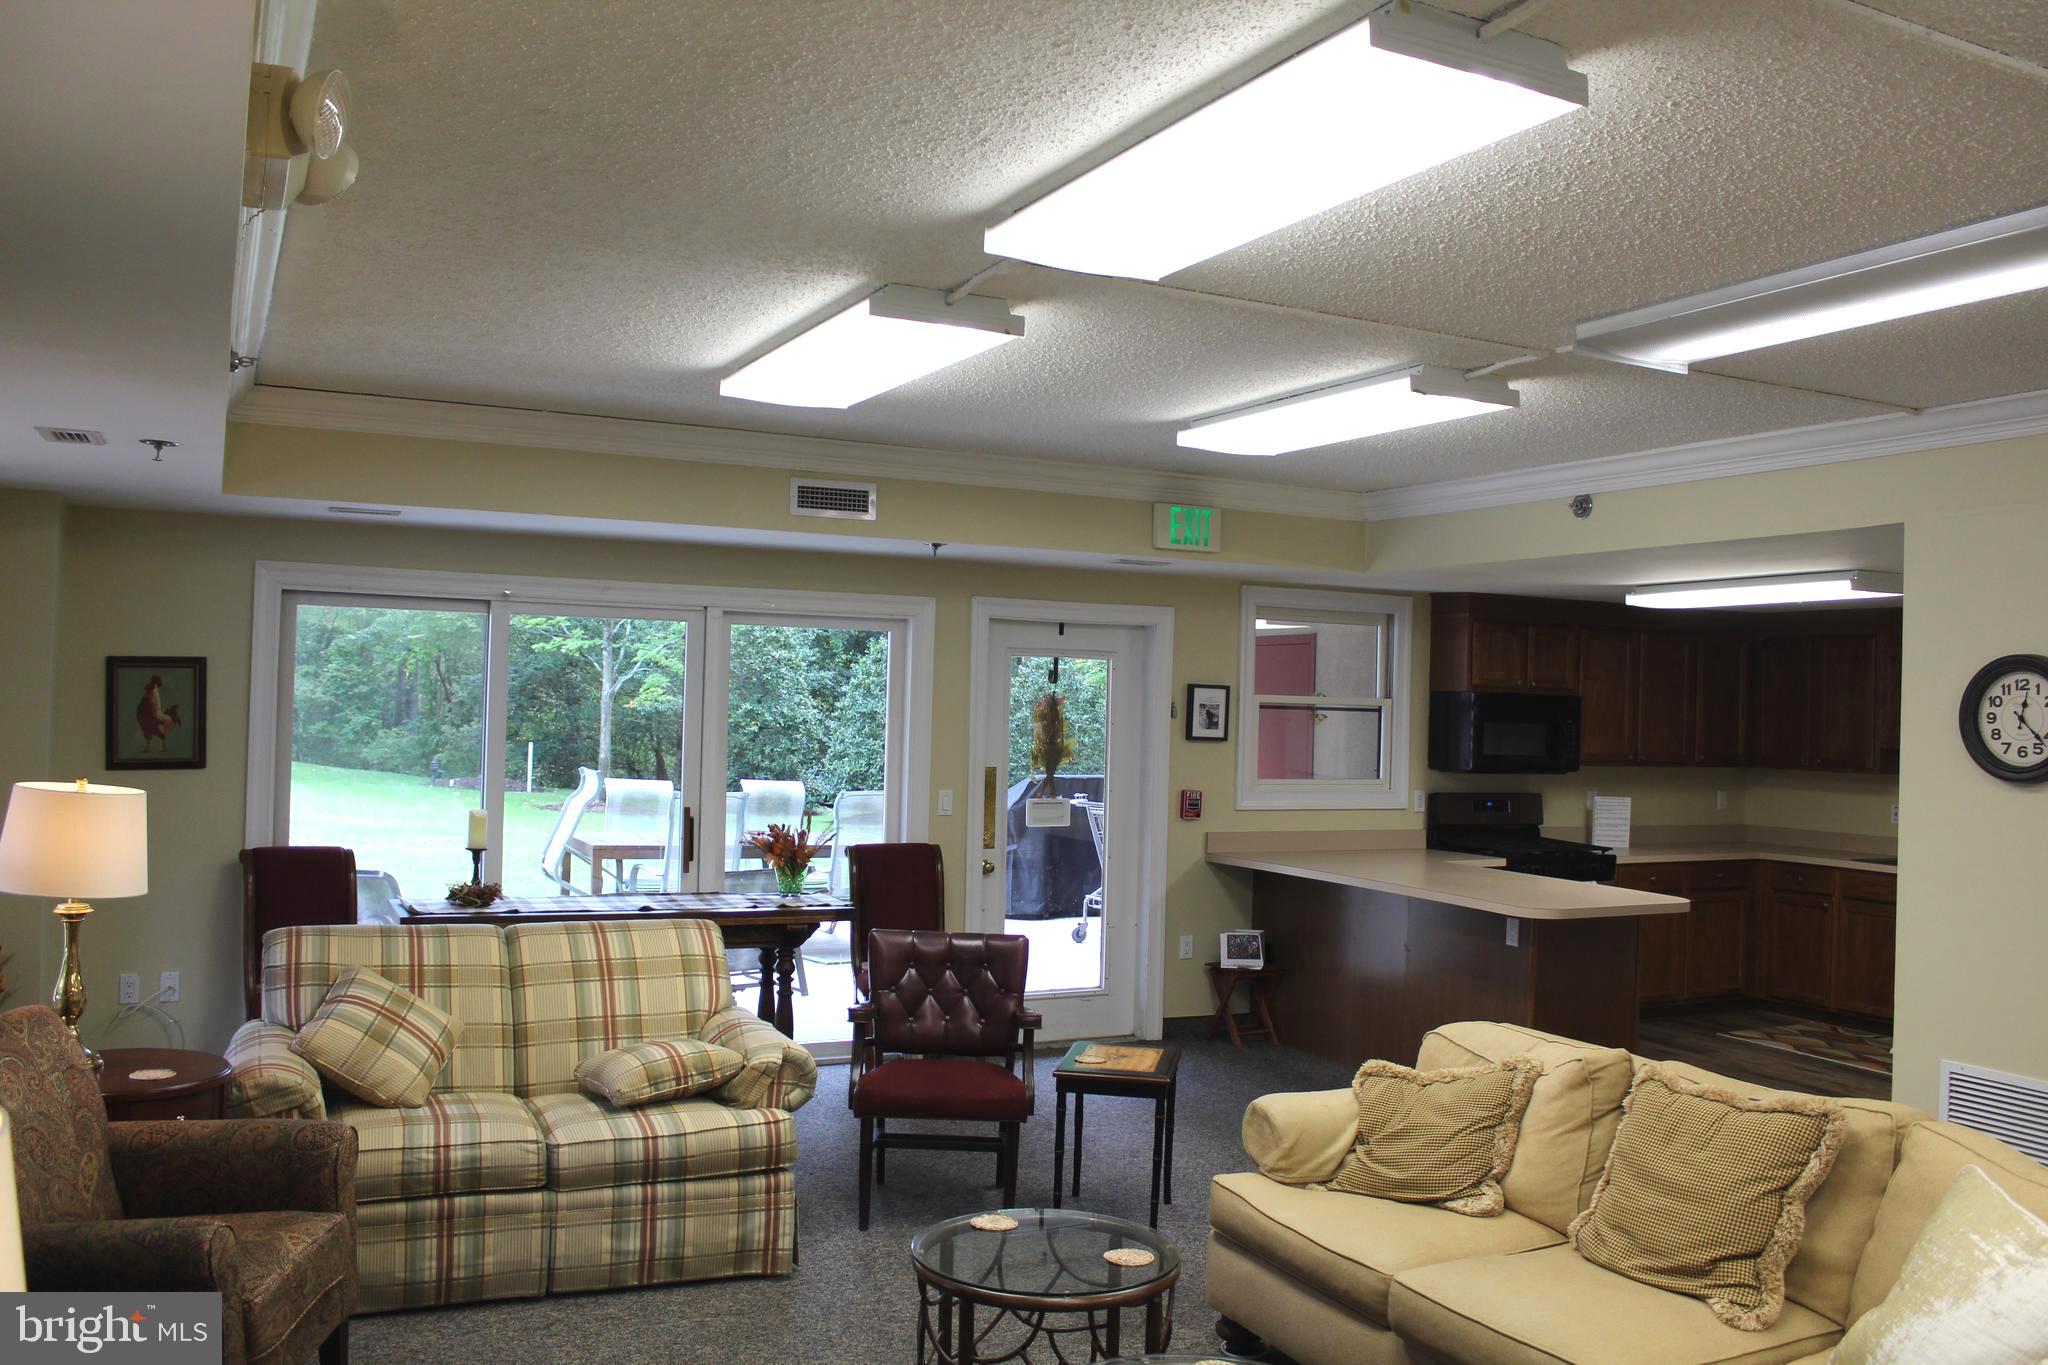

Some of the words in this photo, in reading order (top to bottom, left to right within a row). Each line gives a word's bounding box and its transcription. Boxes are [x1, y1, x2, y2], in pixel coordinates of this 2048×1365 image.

[1168, 505, 1214, 546] EXIT
[2001, 683, 2012, 695] 11
[2014, 678, 2030, 691] 12
[2035, 683, 2041, 695] 1
[1988, 696, 2003, 708] 10
[1986, 712, 1997, 724] 9
[1991, 728, 2002, 740] 8
[2001, 742, 2012, 755] 7
[2017, 746, 2028, 758] 6
[2033, 742, 2044, 755] 5
[1186, 791, 1201, 799] FIRE
